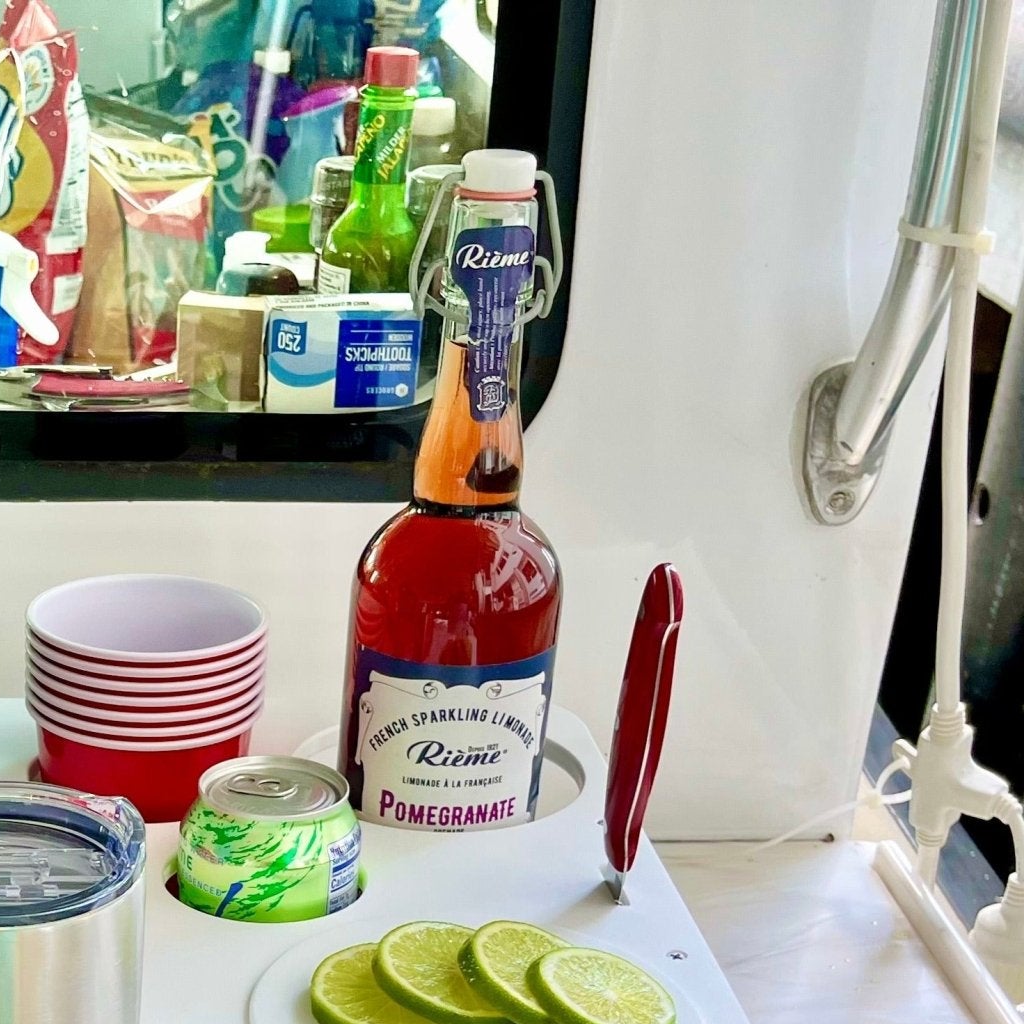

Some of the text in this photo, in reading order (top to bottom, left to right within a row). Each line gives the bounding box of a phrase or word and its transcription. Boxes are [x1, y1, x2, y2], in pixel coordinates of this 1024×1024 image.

[375, 126, 406, 163] MILDER
[456, 244, 530, 269] Rième
[277, 331, 302, 353] 250
[345, 347, 413, 362] TOOTHPICKS
[369, 708, 535, 751] FRENCH SPARKLING LIMONADE
[402, 776, 503, 788] LIMONADE À LA FRANÇAISE
[379, 789, 516, 826] POMEGRANATE
